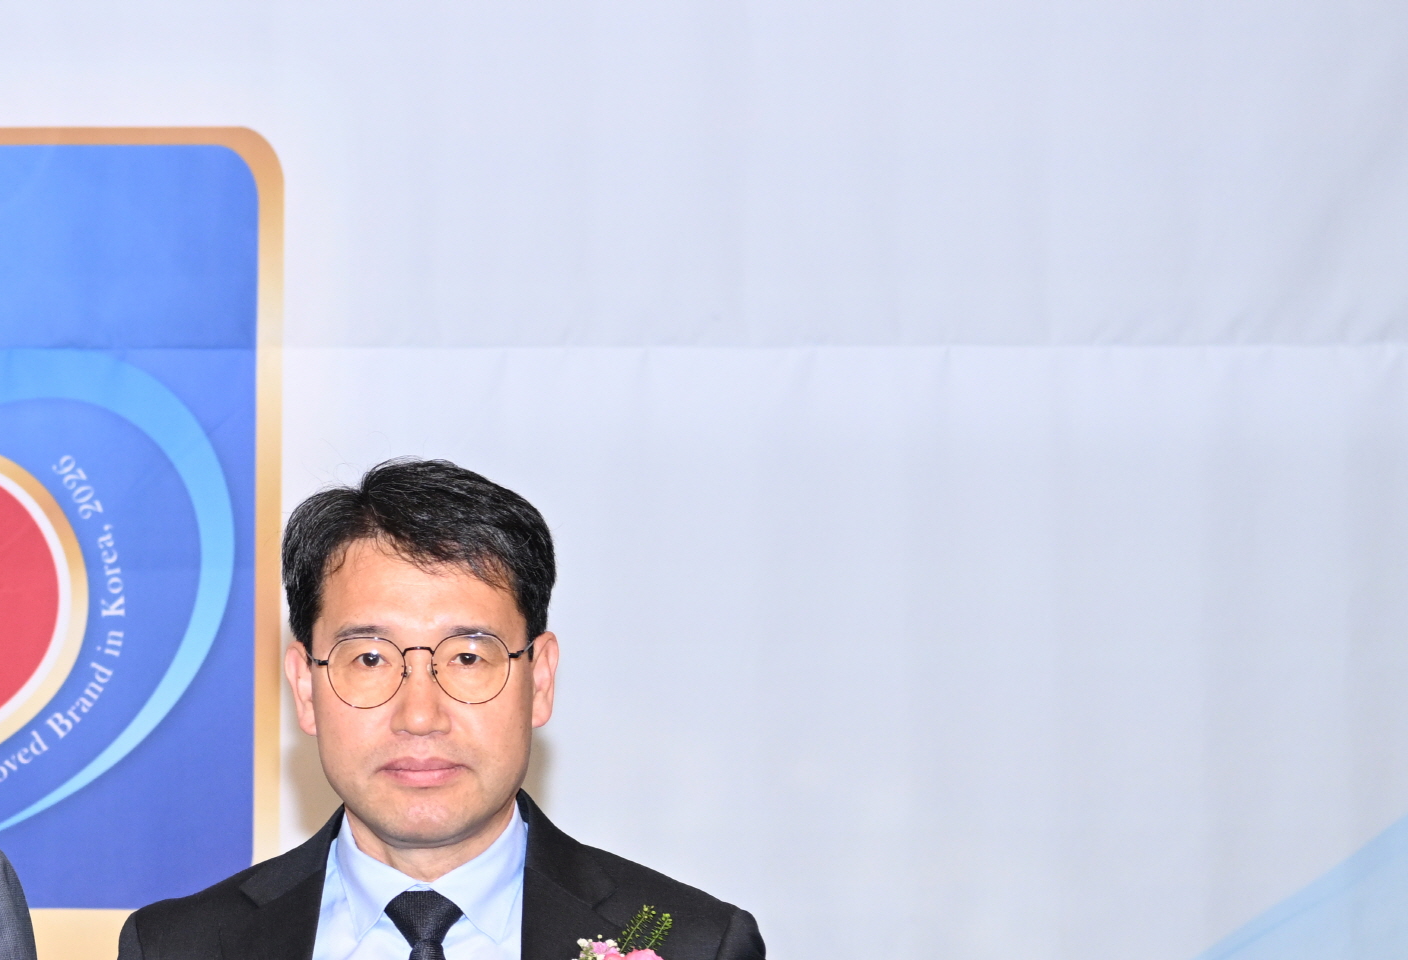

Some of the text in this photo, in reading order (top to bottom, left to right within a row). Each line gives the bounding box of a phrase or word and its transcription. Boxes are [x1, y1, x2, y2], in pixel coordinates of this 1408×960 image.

[52, 454, 104, 520] 2026
[97, 524, 125, 617] Korea,
[97, 630, 124, 658] in
[46, 662, 113, 739] Brand
